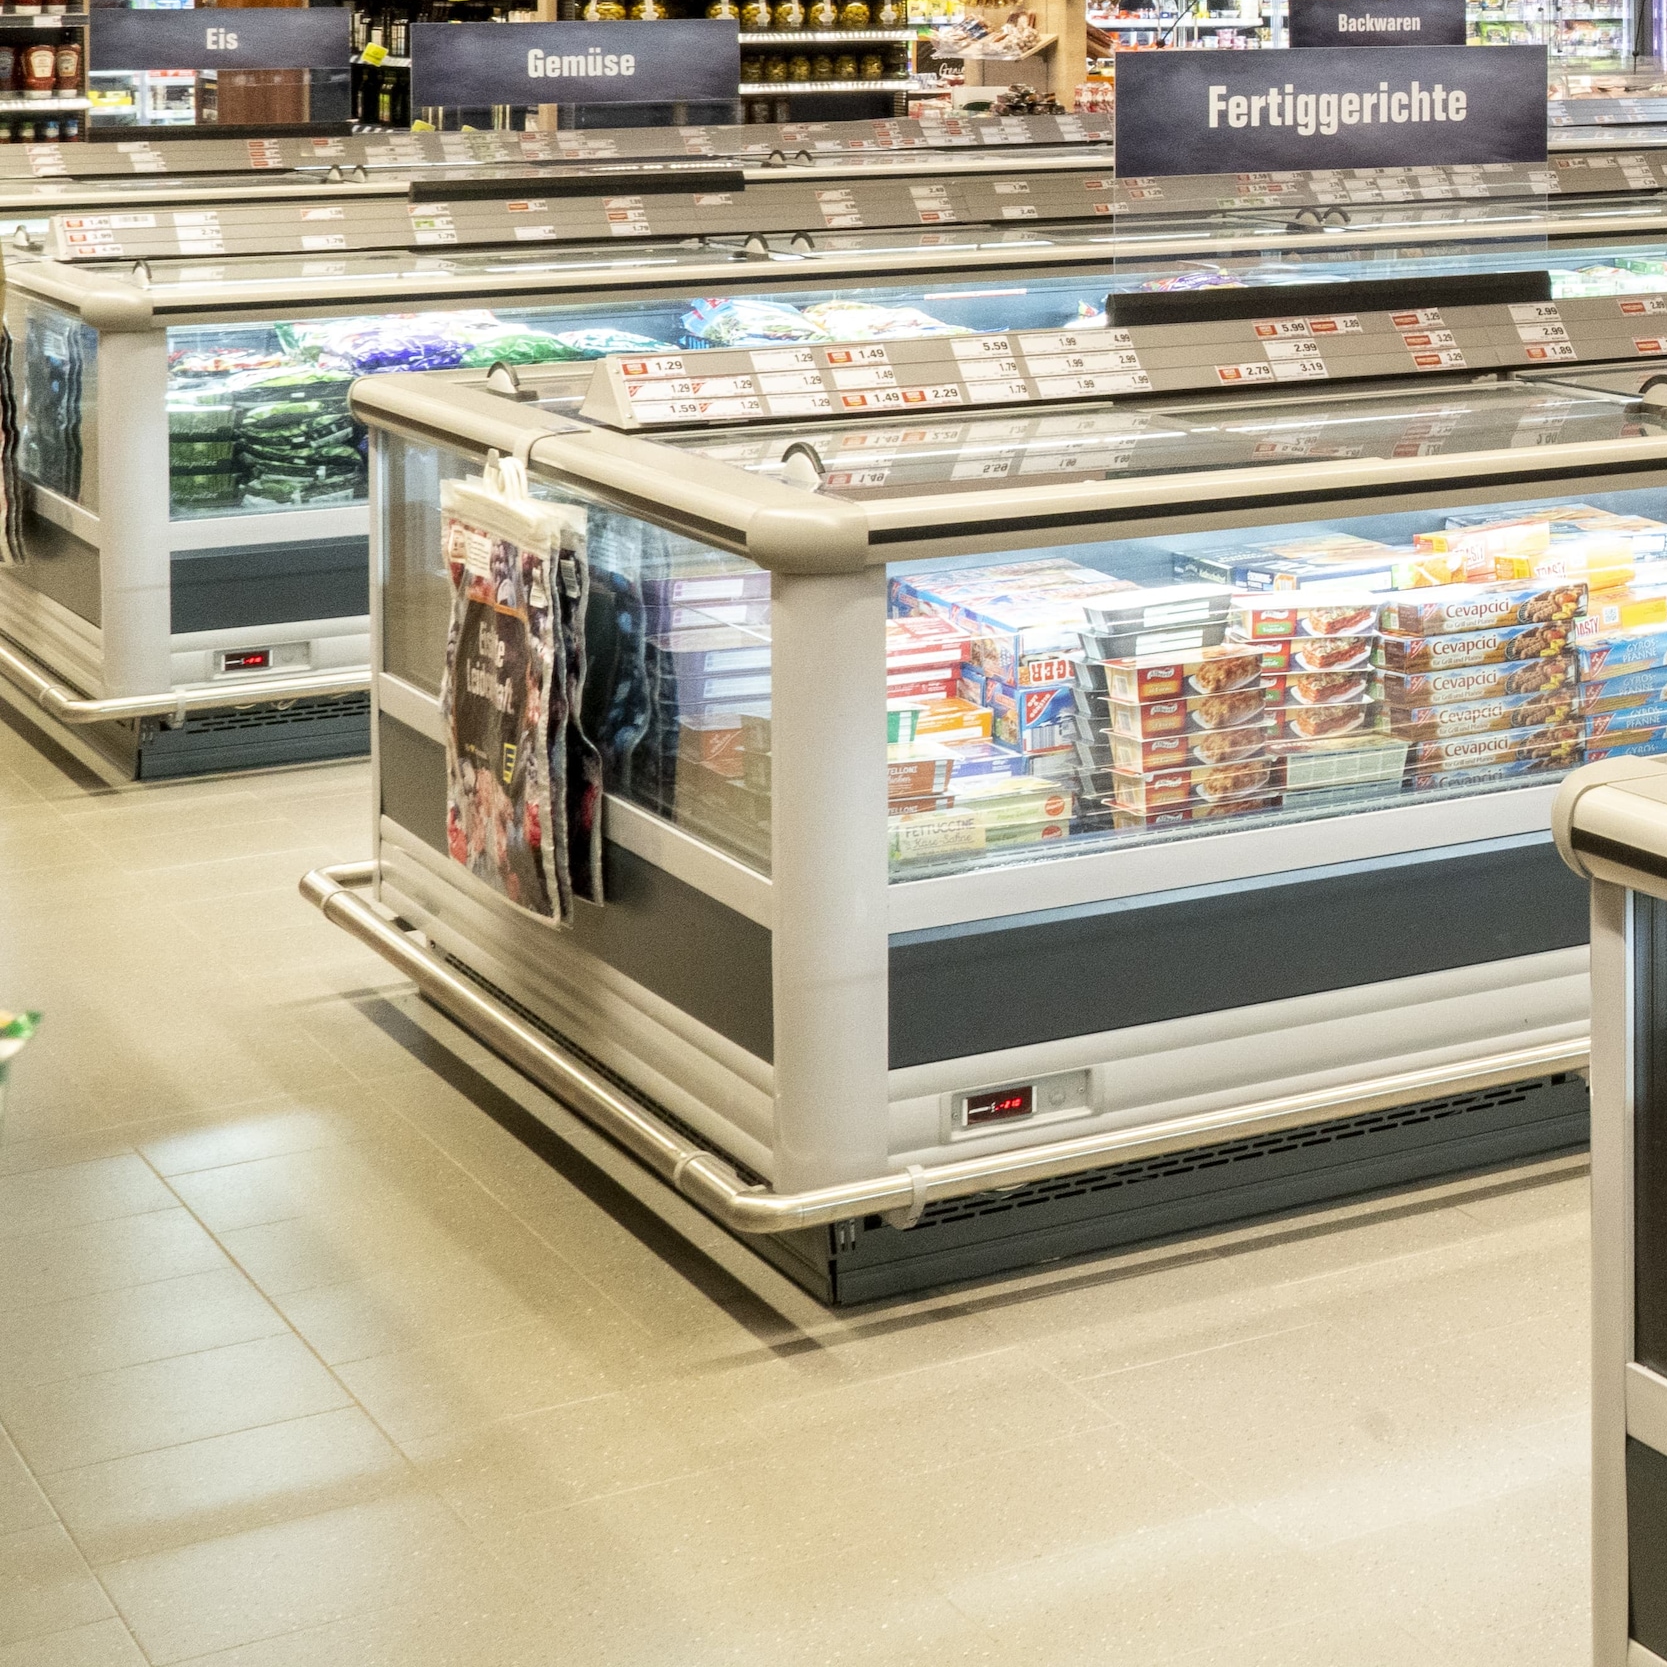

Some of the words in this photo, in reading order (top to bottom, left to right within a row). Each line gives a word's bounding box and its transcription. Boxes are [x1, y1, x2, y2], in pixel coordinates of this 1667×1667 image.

[1338, 13, 1421, 33] Backwaren
[205, 27, 239, 51] Eis
[526, 49, 636, 81] Gemüse
[1209, 81, 1468, 136] Fertiggerichte
[1281, 322, 1305, 333] 5.99
[1542, 325, 1565, 336] 2.99
[982, 341, 1008, 351] 5.59
[1059, 337, 1077, 347] 1.99
[1293, 343, 1317, 353] 2.99
[1550, 345, 1573, 355] 1.89
[794, 353, 813, 363] 1.29
[858, 349, 884, 359] 1.49
[1066, 359, 1084, 368] 1.99
[1119, 355, 1137, 364] 2.99
[655, 360, 682, 371] 1.29
[999, 362, 1017, 372] 1.79
[1300, 362, 1324, 372] 3.19
[875, 370, 894, 380] 1.49
[1246, 366, 1270, 376] 2.79
[733, 380, 752, 390] 1.29
[803, 375, 822, 385] 1.29
[1131, 375, 1149, 385] 1.99
[671, 384, 690, 393] 1.29
[1009, 385, 1027, 394] 1.79
[874, 393, 900, 403] 1.49
[932, 389, 958, 399] 2.29
[740, 400, 760, 410] 1.29
[812, 398, 831, 407] 1.29
[670, 404, 697, 414] 1.59
[1445, 598, 1510, 619] Cevapcici
[1432, 634, 1497, 656] Cevapcici
[1626, 636, 1659, 653] GYROS-
[1622, 647, 1657, 663] PFANNE
[1432, 670, 1497, 691] Cevapcici
[1438, 703, 1503, 725] Cevapcici
[1444, 737, 1509, 758] Cevapcici
